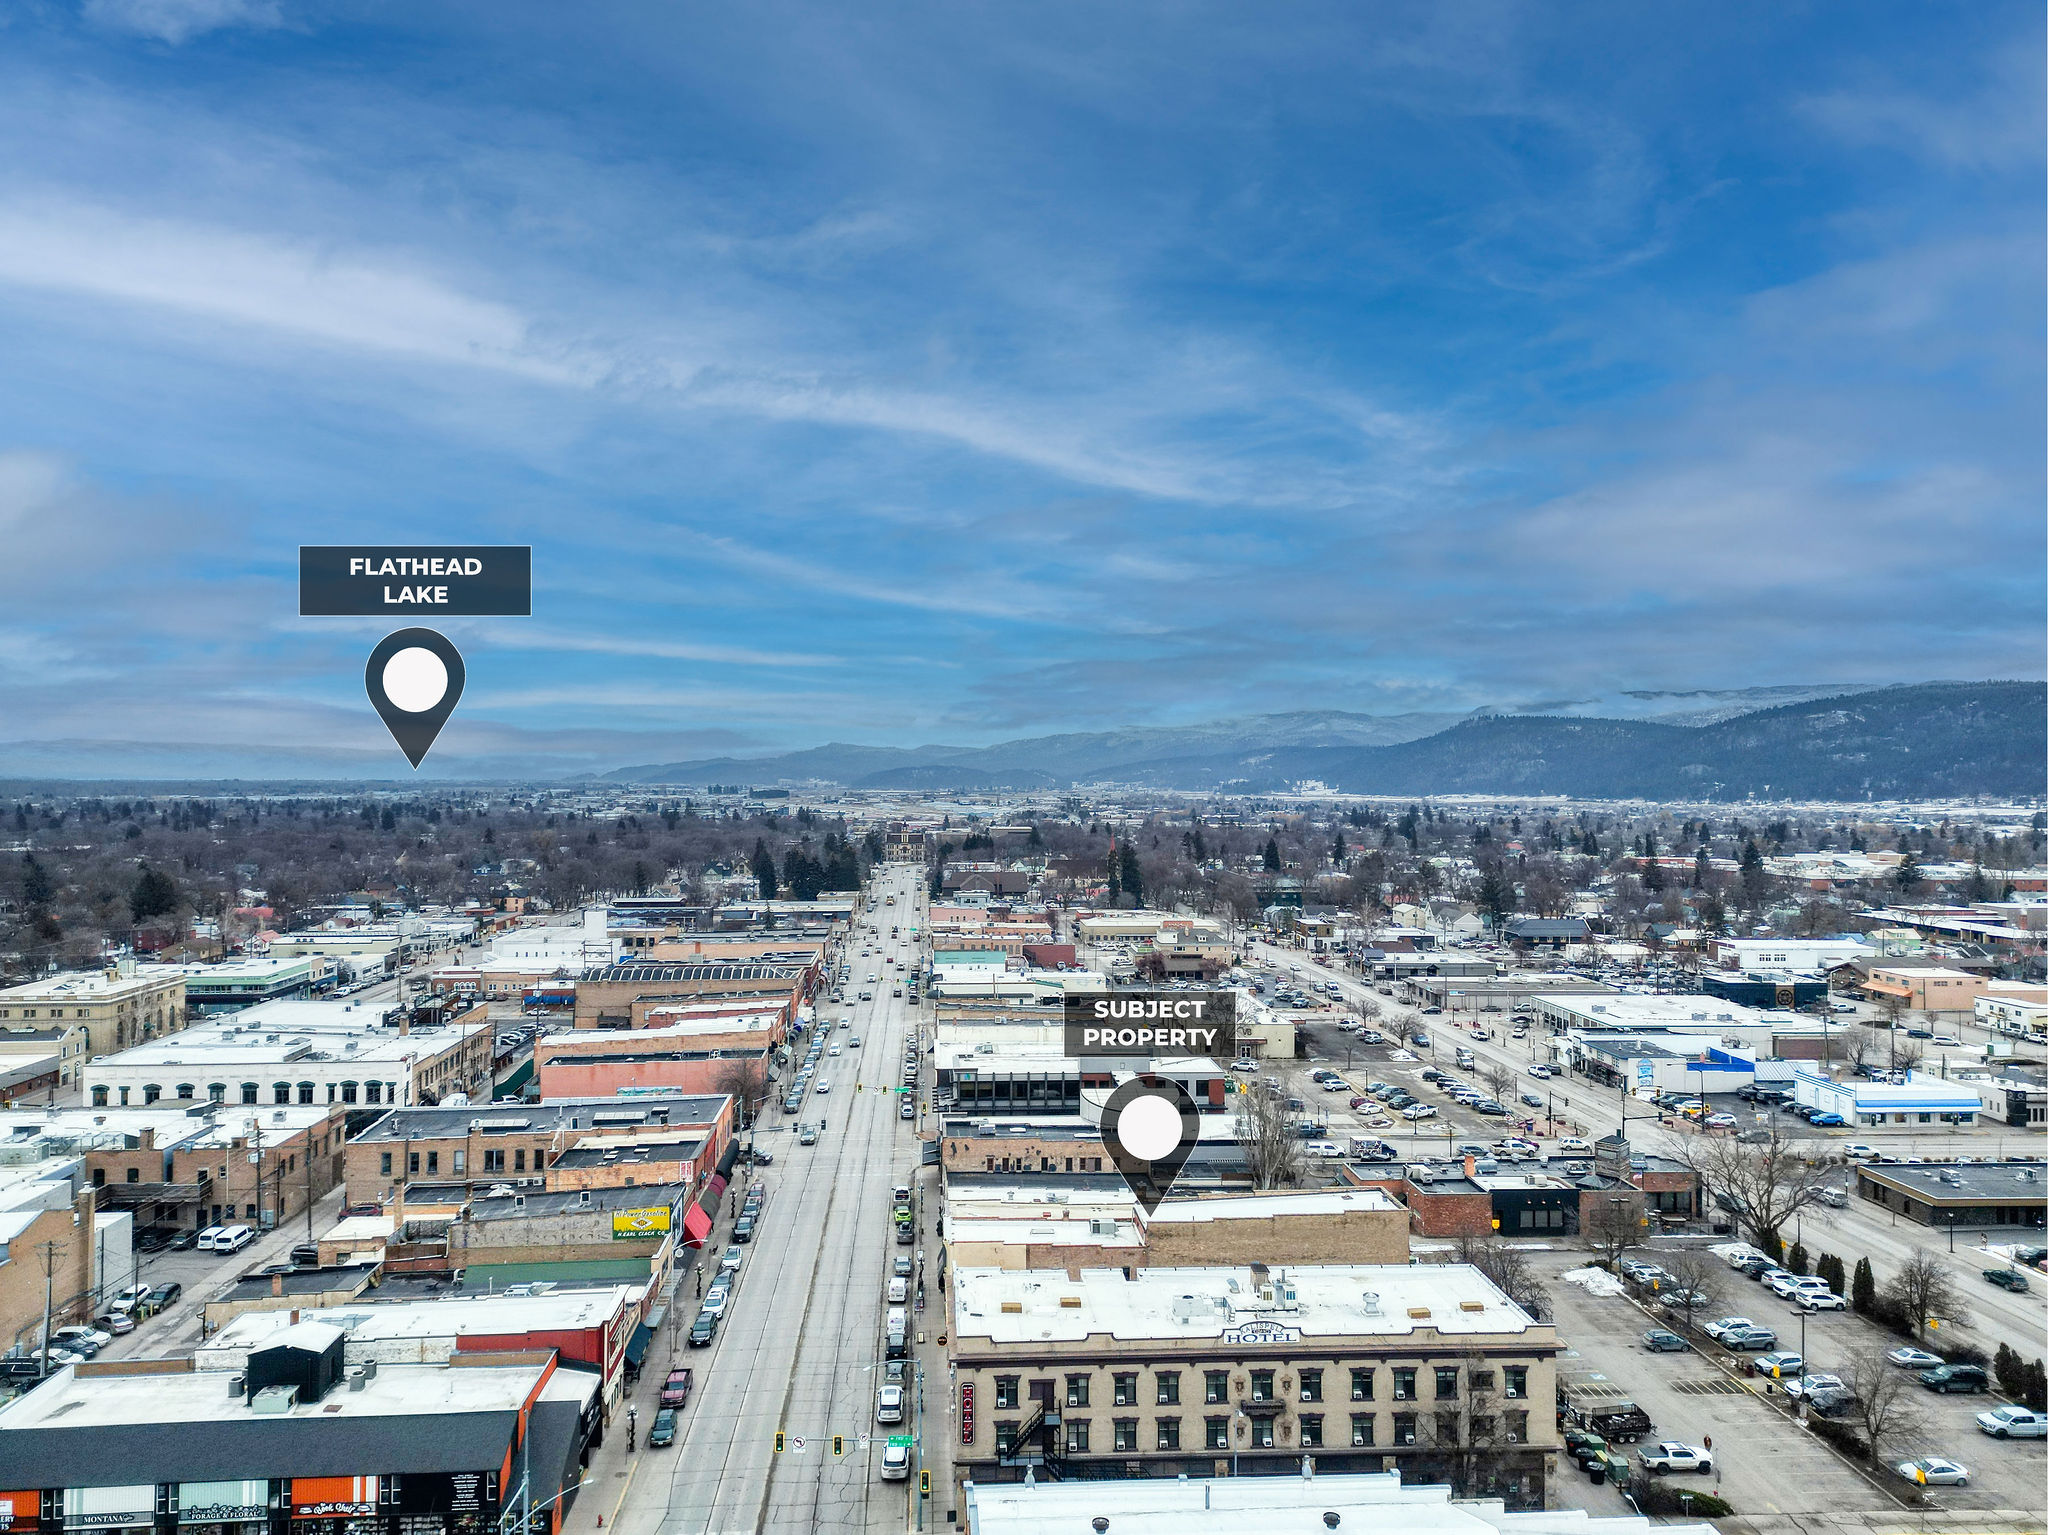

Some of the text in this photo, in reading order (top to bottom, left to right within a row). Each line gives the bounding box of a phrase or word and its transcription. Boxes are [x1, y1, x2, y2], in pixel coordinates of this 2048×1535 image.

[641, 1209, 667, 1218] Gasoline
[1240, 1322, 1284, 1335] KALISPELL
[1227, 1334, 1297, 1343] HOTEL
[963, 1386, 973, 1443] HOTEL
[83, 1515, 123, 1523] MONTANA
[191, 1512, 220, 1520] FORAGE
[230, 1510, 258, 1518] FLORAL
